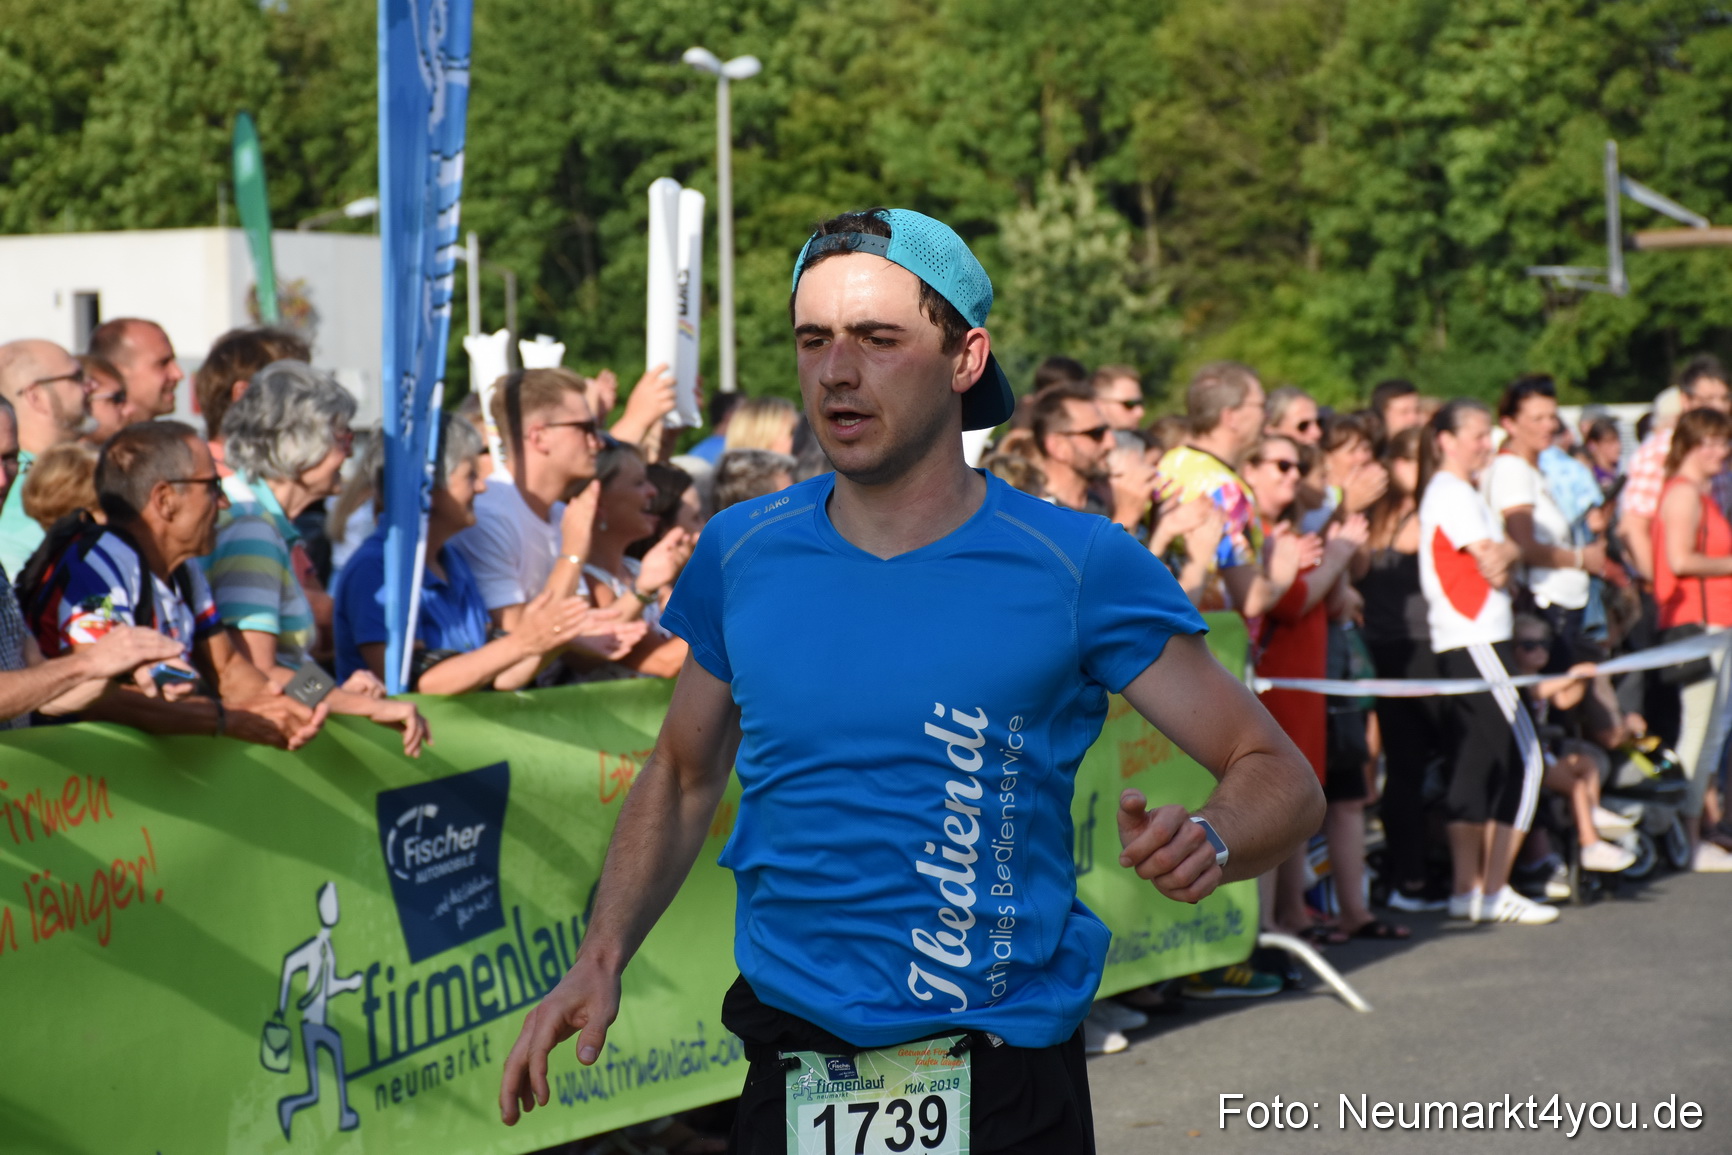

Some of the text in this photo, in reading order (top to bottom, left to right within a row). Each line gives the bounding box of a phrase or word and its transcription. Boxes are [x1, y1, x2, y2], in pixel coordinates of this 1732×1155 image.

[763, 496, 791, 514] JAKO
[0, 775, 113, 846] irmen
[990, 714, 1025, 896] Bedienservice
[403, 823, 486, 870] Fischer
[375, 1032, 492, 1112] neumarkt
[816, 1075, 885, 1094] firmenlauf
[904, 1077, 960, 1095] run 2019
[816, 1092, 849, 1100] neumarkt
[813, 1095, 948, 1155] 1739
